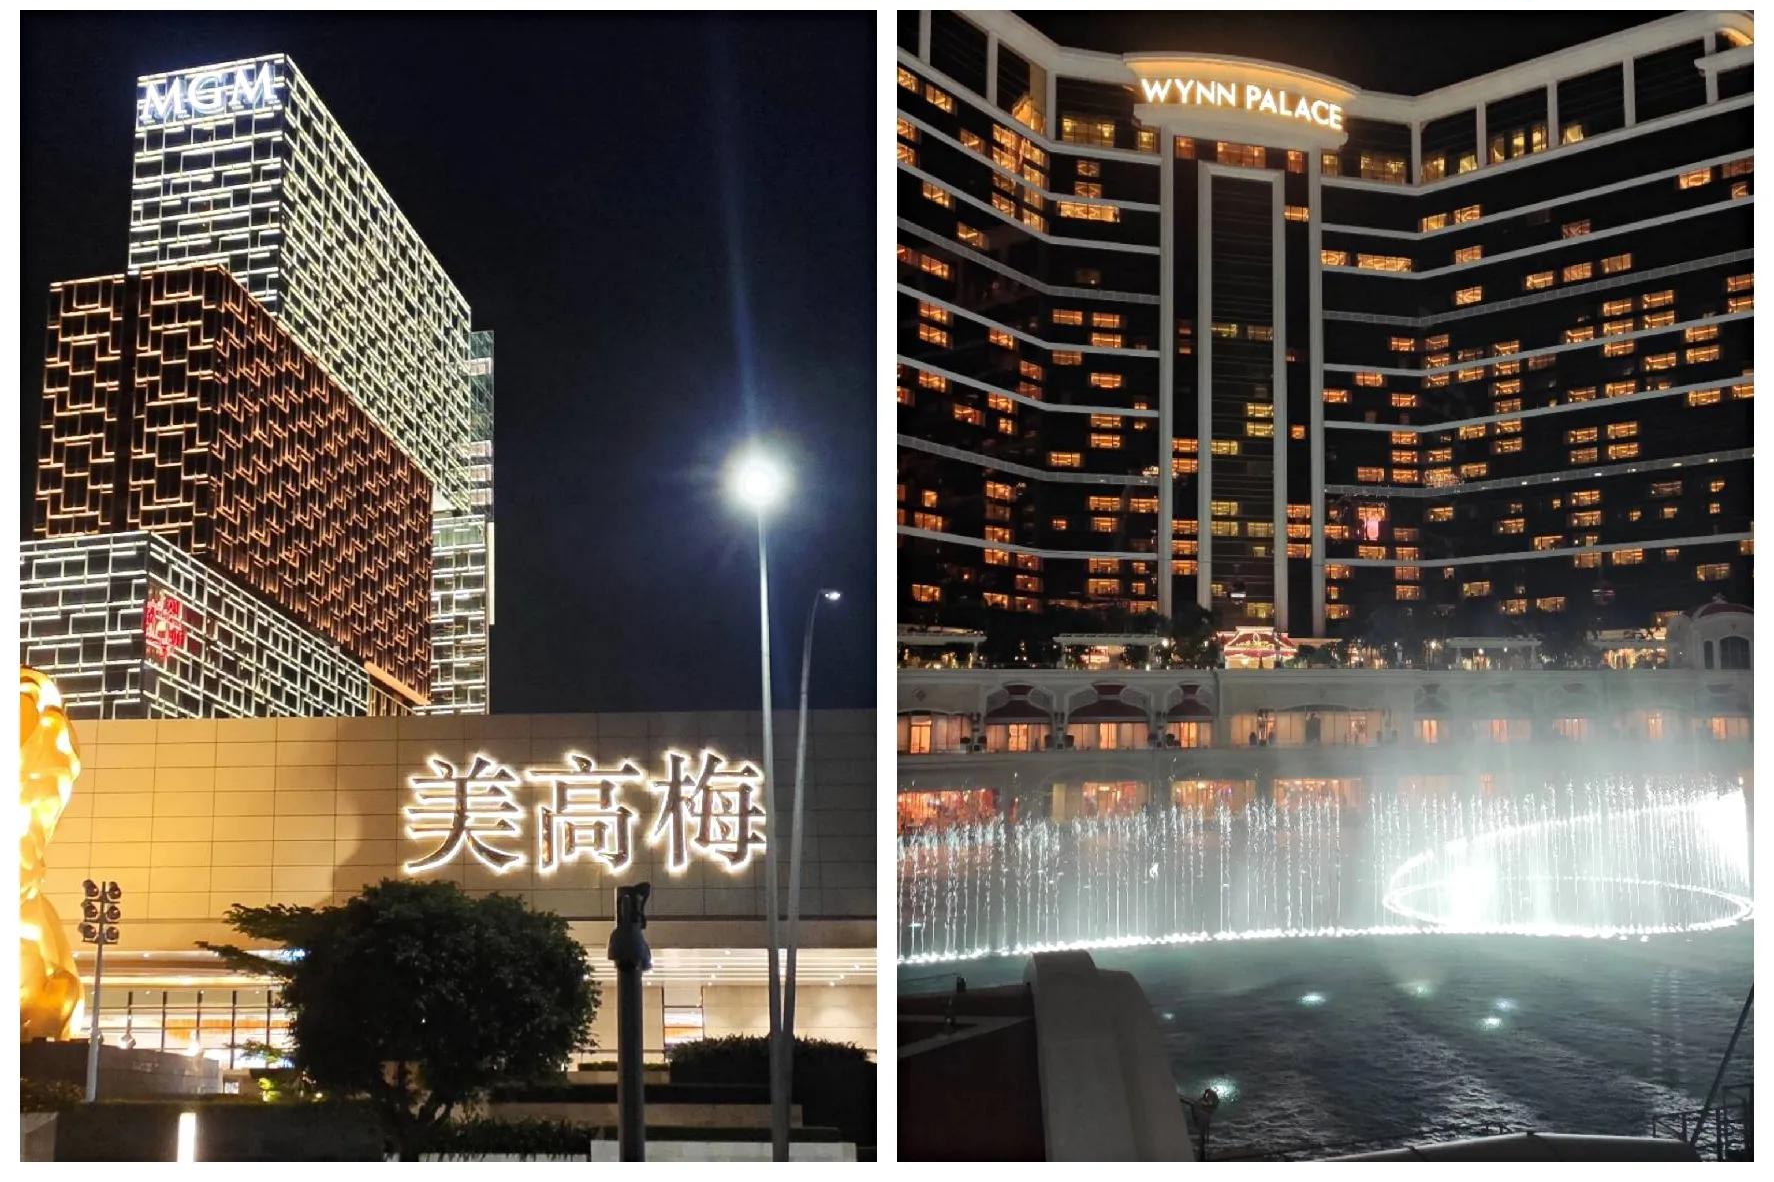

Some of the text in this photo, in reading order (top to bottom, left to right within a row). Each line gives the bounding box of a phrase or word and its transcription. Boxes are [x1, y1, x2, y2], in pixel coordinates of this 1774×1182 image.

[139, 61, 284, 124] MGM
[1140, 77, 1344, 131] WYNN PALACE
[402, 750, 767, 875] 美高梅
